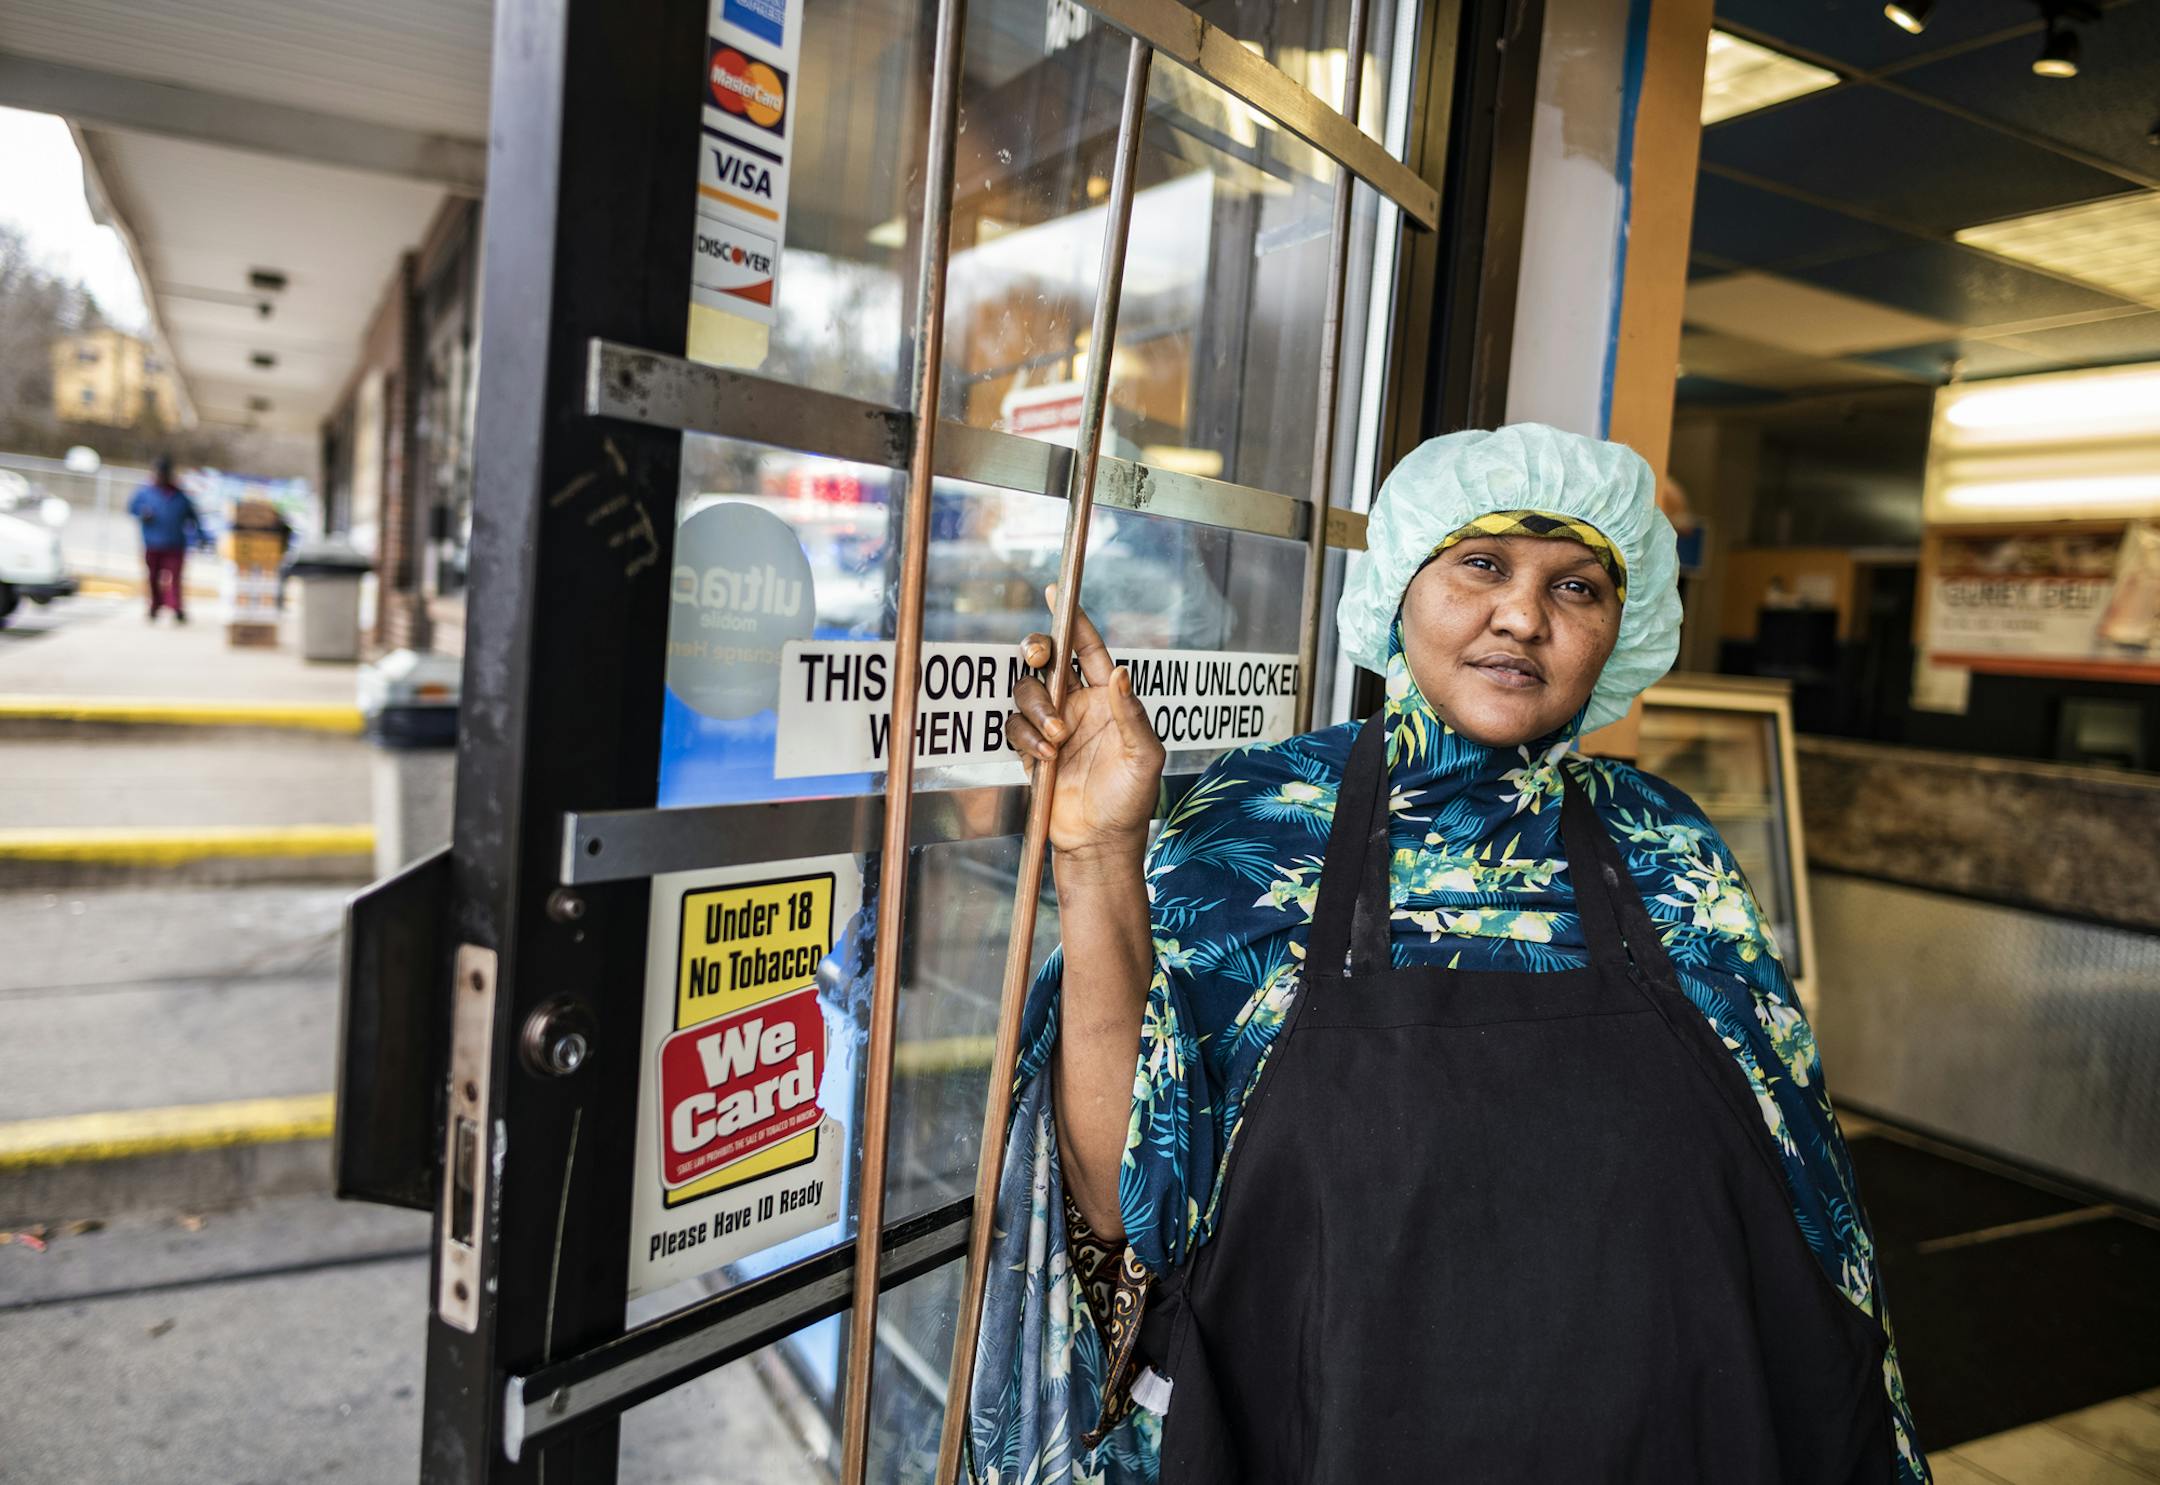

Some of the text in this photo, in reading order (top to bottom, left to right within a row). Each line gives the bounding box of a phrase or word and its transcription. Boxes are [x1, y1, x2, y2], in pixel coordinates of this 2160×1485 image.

[711, 64, 783, 112] MasterCard
[711, 149, 772, 199] VISA
[698, 236, 771, 274] DISCOVER
[799, 654, 887, 702] THIS
[917, 655, 997, 700] OOR
[1115, 659, 1189, 697] MAIN
[1154, 704, 1265, 744] OCCUPIED
[705, 890, 813, 945] Under 18
[688, 943, 823, 999] No Tobacco
[696, 1016, 797, 1089] We
[671, 1051, 816, 1154] Card
[745, 1131, 758, 1147] SALE
[766, 1119, 789, 1138] TOBACCO
[649, 1179, 824, 1262] Please Have ID Ready
